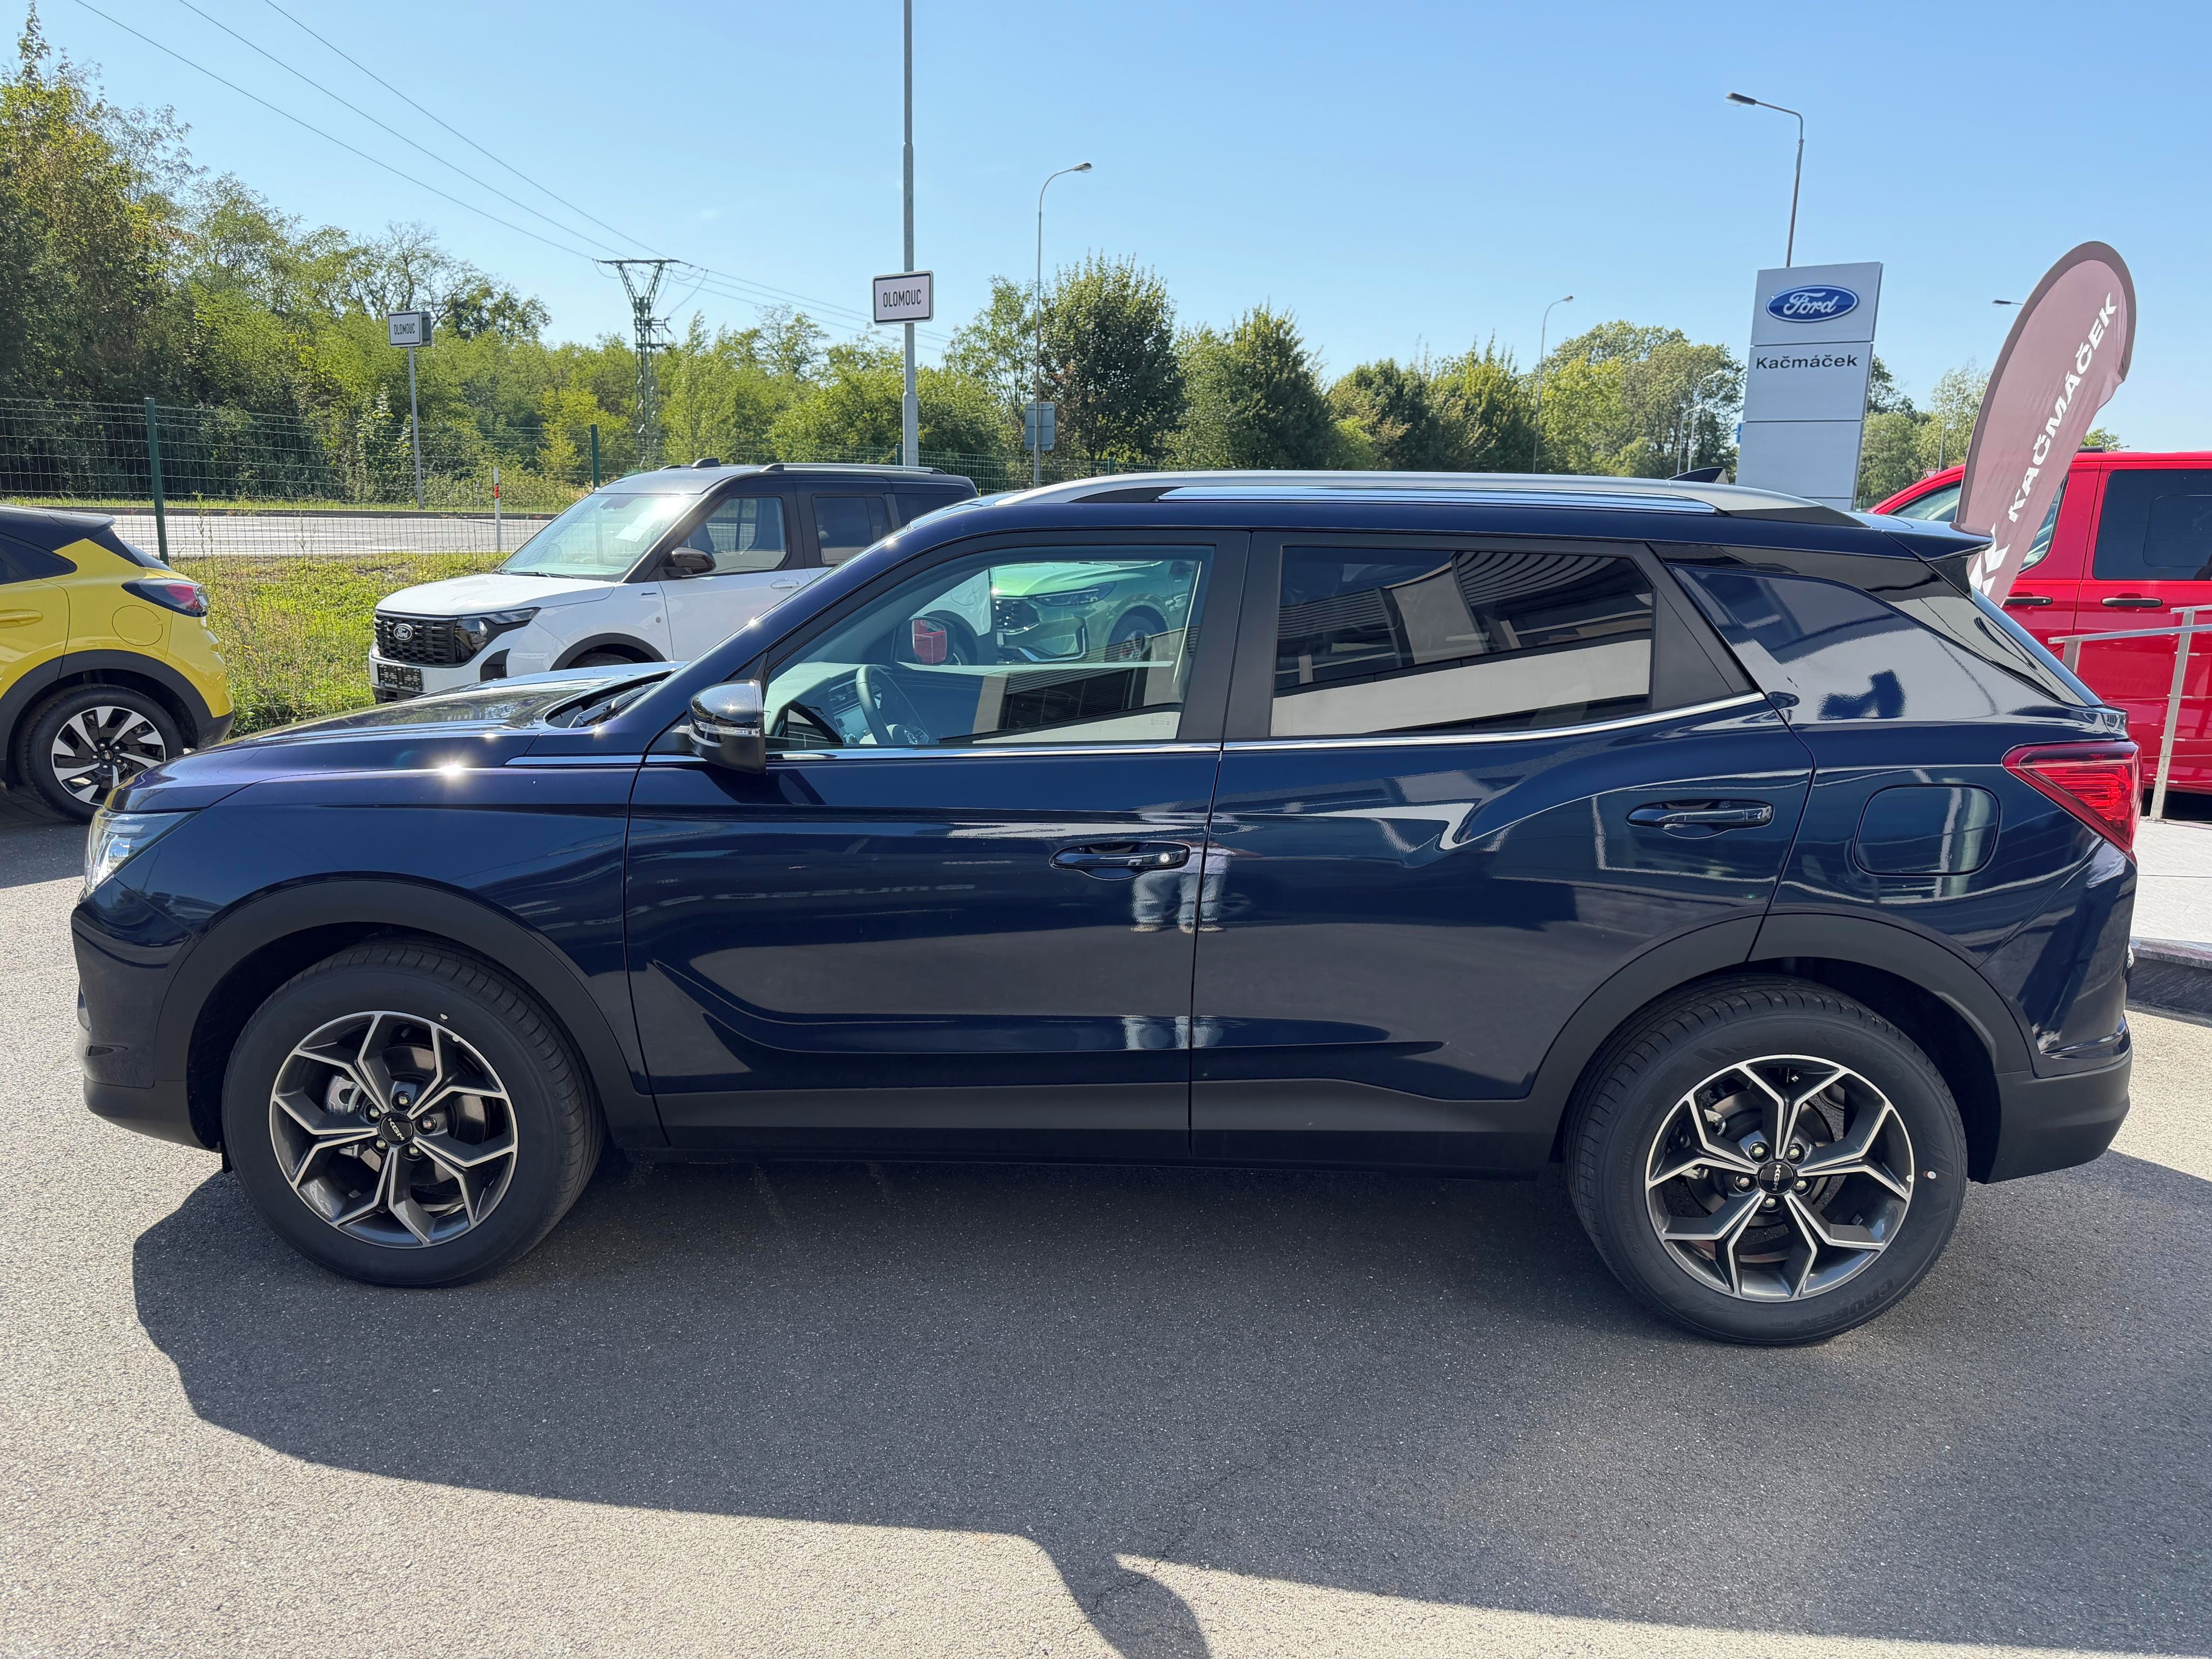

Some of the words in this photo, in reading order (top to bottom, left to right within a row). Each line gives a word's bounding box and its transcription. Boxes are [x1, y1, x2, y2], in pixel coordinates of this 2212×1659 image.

[883, 289, 921, 307] OLOMOUC
[1783, 292, 1839, 315] Ford
[394, 323, 415, 335] OLOMOUC
[1756, 354, 1858, 369] Kačmáček
[2008, 292, 2116, 523] KAČMÁČEK
[388, 1117, 405, 1141] KGM
[1772, 1164, 1782, 1191] KGM
